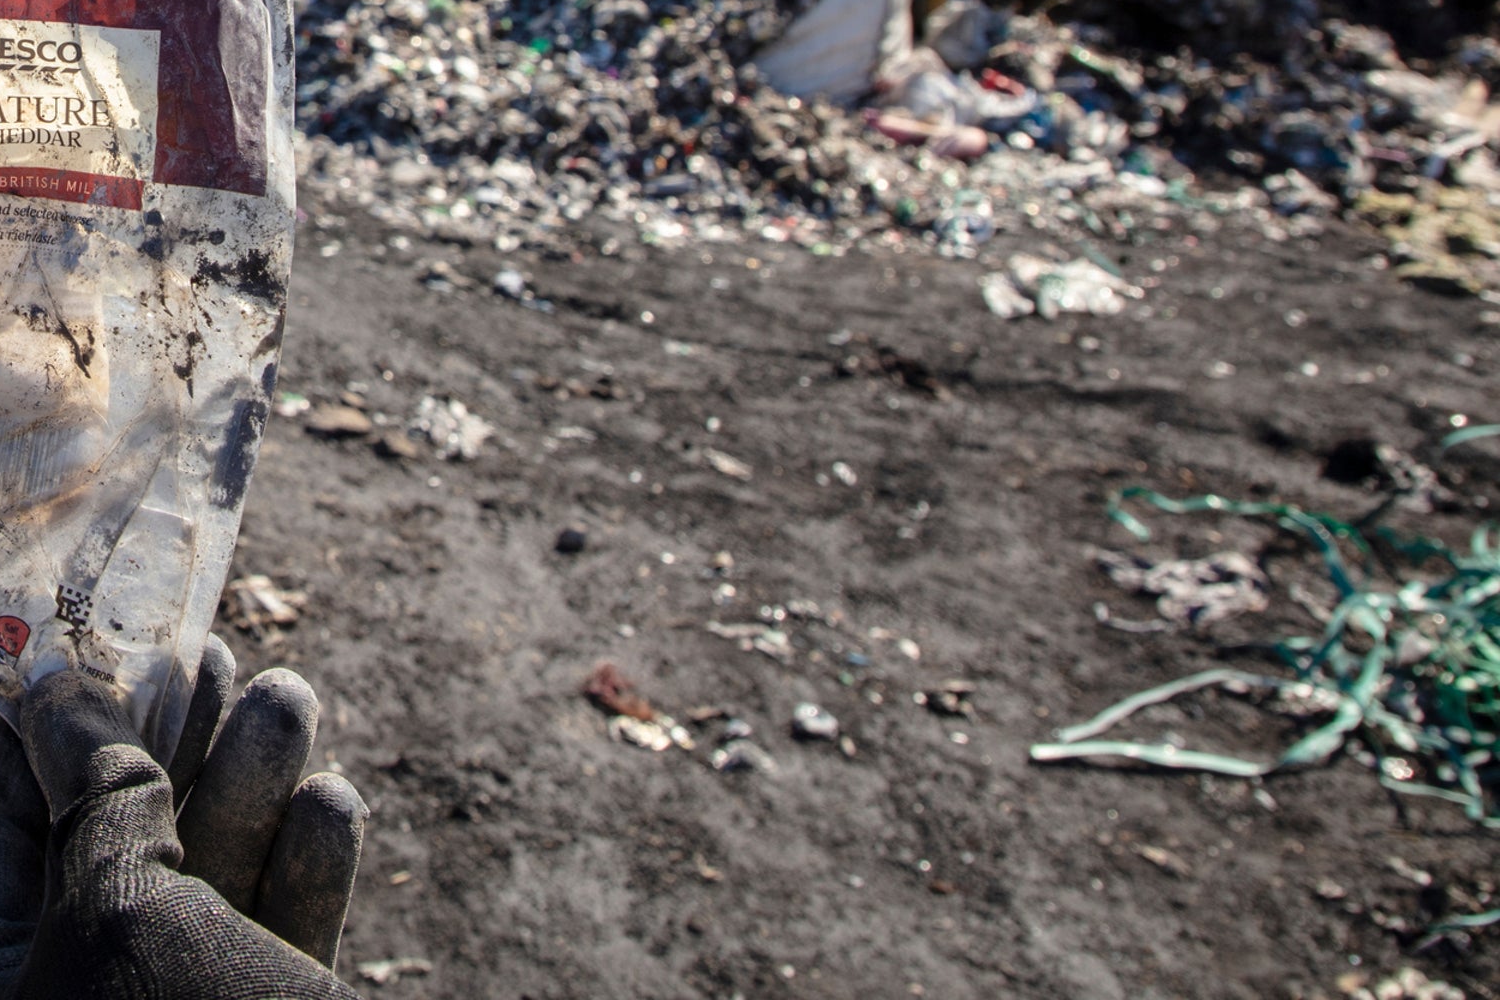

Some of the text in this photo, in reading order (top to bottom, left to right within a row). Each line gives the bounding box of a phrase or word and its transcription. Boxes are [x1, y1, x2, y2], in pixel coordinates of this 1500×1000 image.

[0, 175, 59, 191] BRITISH
[66, 180, 99, 196] MIL
[13, 204, 58, 221] selected
